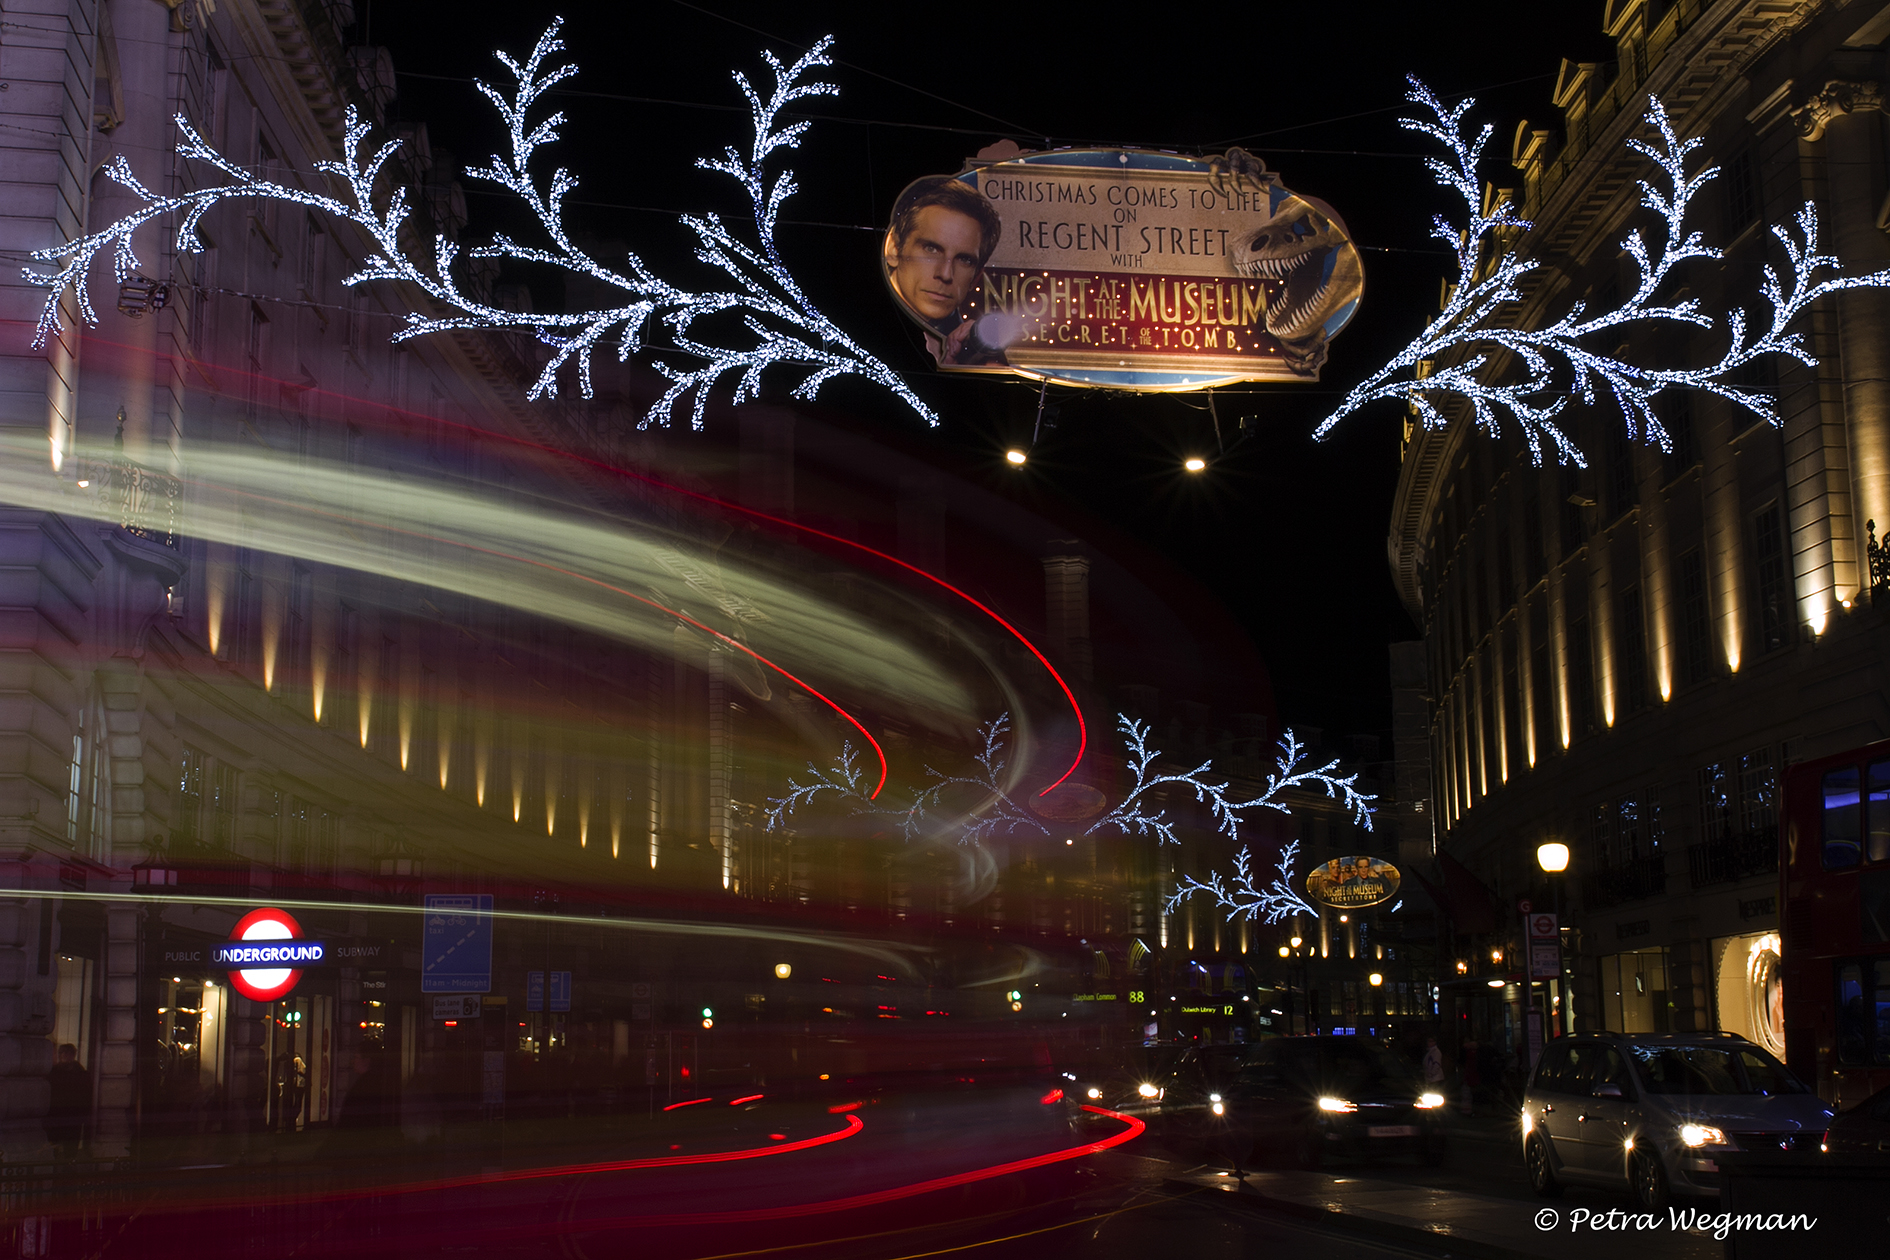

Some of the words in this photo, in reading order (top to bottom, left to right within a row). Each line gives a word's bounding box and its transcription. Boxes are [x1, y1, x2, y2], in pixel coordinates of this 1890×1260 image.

[985, 179, 1097, 205] CHRISTMAS
[1107, 185, 1179, 209] COMES
[1188, 188, 1216, 210] TO
[1226, 191, 1261, 212] LIFE
[1113, 207, 1137, 223] ON
[1019, 220, 1124, 252] REGENT
[1140, 226, 1230, 256] STREET
[1110, 253, 1143, 268] WITH
[982, 271, 1092, 320] NIGHT
[1099, 278, 1119, 300] AT
[1130, 276, 1267, 327] MUSEUM
[1094, 299, 1122, 320] THE
[1022, 322, 1128, 345] SECRET
[1139, 327, 1151, 337] OF
[1161, 328, 1237, 349] TOMB
[1138, 336, 1152, 346] THE
[1323, 885, 1346, 898] NIGHT
[1353, 883, 1384, 896] MUSEUM
[1520, 900, 1530, 912] G
[428, 927, 445, 935] taxi
[165, 951, 200, 962] PUBLIC
[212, 945, 324, 963] UNDERGROUND
[337, 946, 381, 958] SUBWAY
[363, 981, 375, 989] The
[424, 979, 445, 987] 11am
[452, 979, 488, 989] Midnight
[1096, 992, 1117, 1001] Common
[1128, 991, 1145, 1003] 88
[1200, 1006, 1216, 1014] Library
[1223, 1005, 1234, 1015] 12
